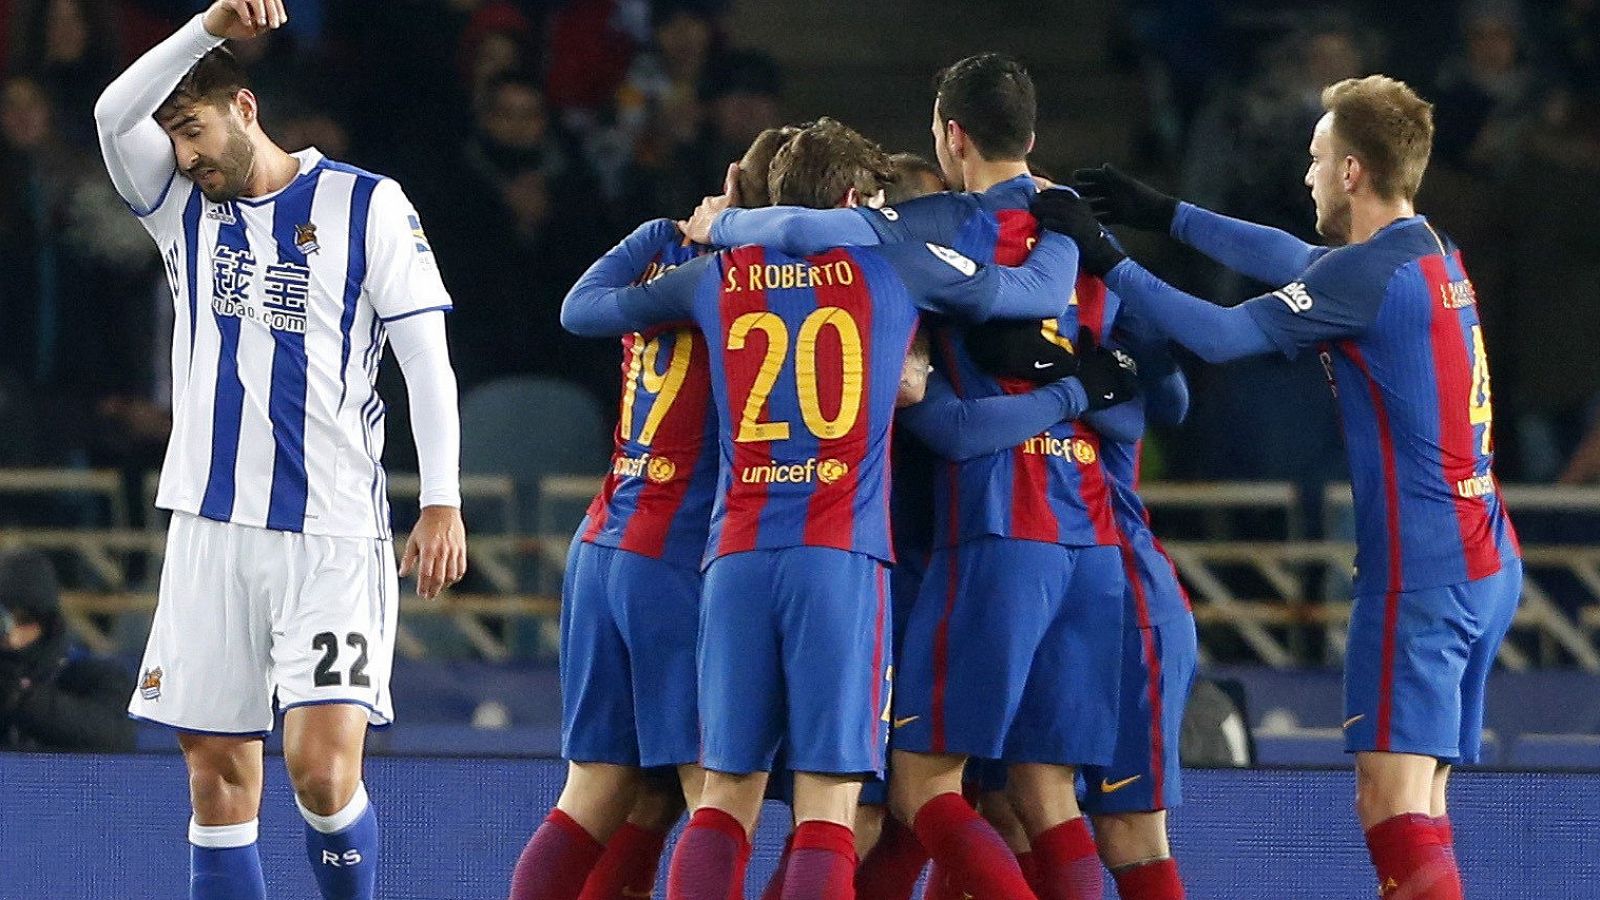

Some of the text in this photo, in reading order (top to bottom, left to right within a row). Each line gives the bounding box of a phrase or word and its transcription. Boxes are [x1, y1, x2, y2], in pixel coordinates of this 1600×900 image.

[725, 261, 853, 292] S. ROBERTO
[621, 330, 692, 446] 19
[727, 306, 863, 442] 20
[1023, 431, 1071, 463] nicf
[741, 459, 816, 483] unicef
[312, 631, 371, 688] 22
[322, 849, 362, 867] RS
